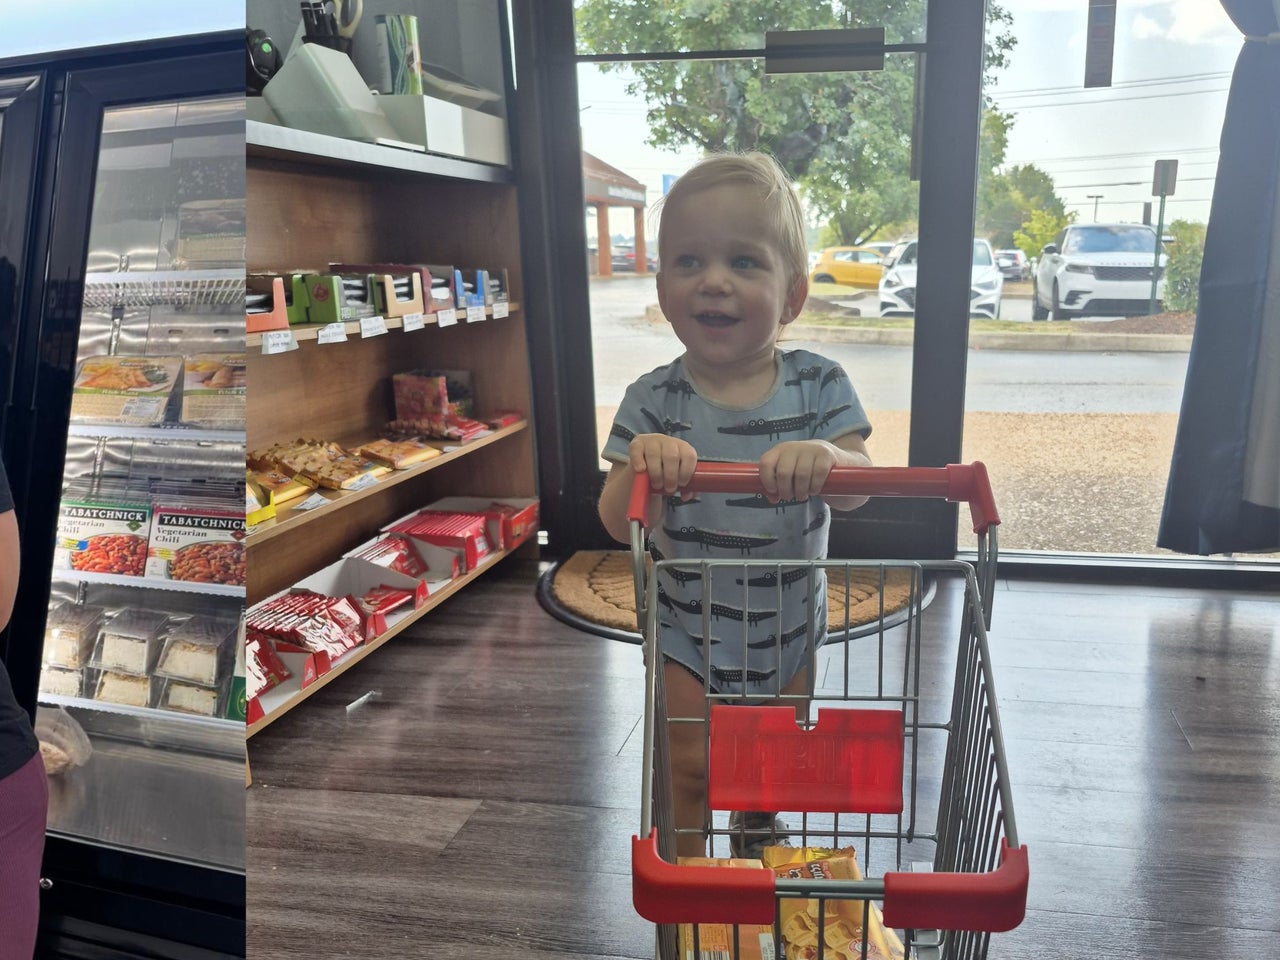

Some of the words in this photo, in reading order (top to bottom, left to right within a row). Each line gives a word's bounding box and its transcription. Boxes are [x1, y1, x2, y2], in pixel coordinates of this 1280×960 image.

[63, 507, 144, 522] TABATCHNICK
[162, 516, 246, 531] TABATCHNICK
[155, 535, 180, 544] Chili
[156, 527, 207, 539] Vegetarian
